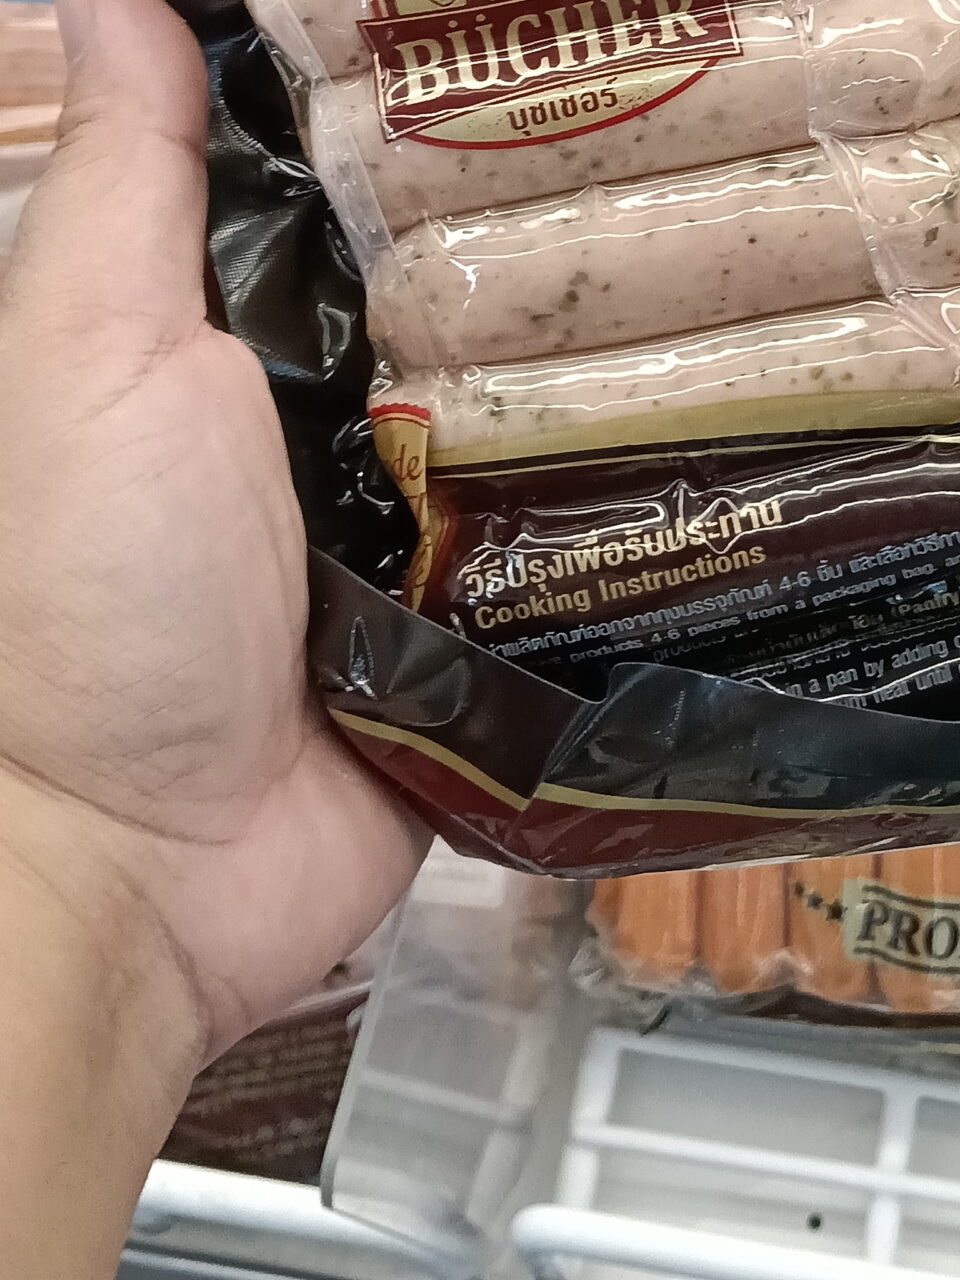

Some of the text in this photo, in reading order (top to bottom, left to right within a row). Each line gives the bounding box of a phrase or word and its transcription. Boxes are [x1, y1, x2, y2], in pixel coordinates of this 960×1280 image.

[474, 543, 767, 629] Cooking Instructions
[650, 627, 683, 644] 4-6
[746, 602, 789, 622] from
[794, 599, 807, 611] a
[812, 572, 897, 608] packaging
[779, 571, 812, 593] 4-6
[826, 667, 859, 693] pan
[863, 657, 886, 680] by
[891, 640, 951, 670] adding
